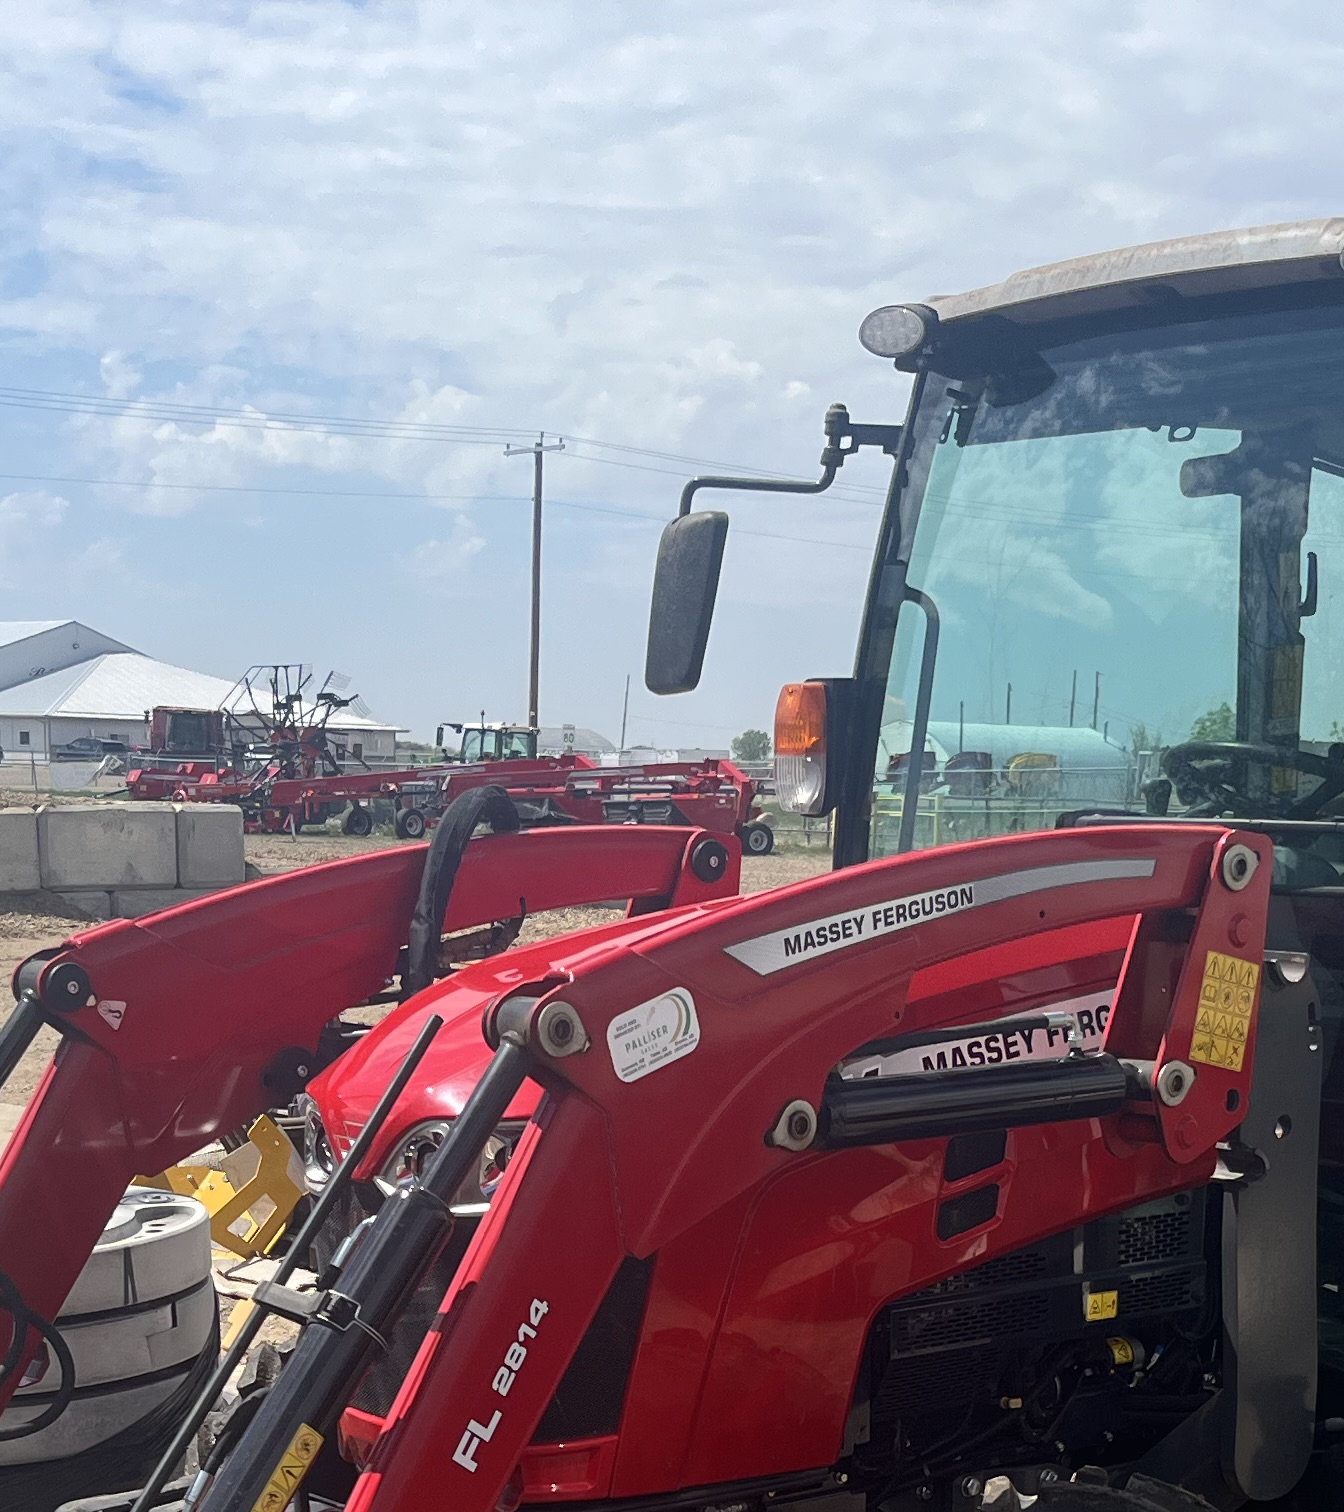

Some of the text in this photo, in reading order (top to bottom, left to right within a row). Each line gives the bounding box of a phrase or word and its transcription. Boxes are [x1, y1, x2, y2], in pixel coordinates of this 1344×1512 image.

[563, 732, 575, 743] 80
[783, 886, 974, 957] MASSEY FERGUSON
[625, 1024, 669, 1054] PALLISER
[452, 1298, 549, 1473] FL 2814
